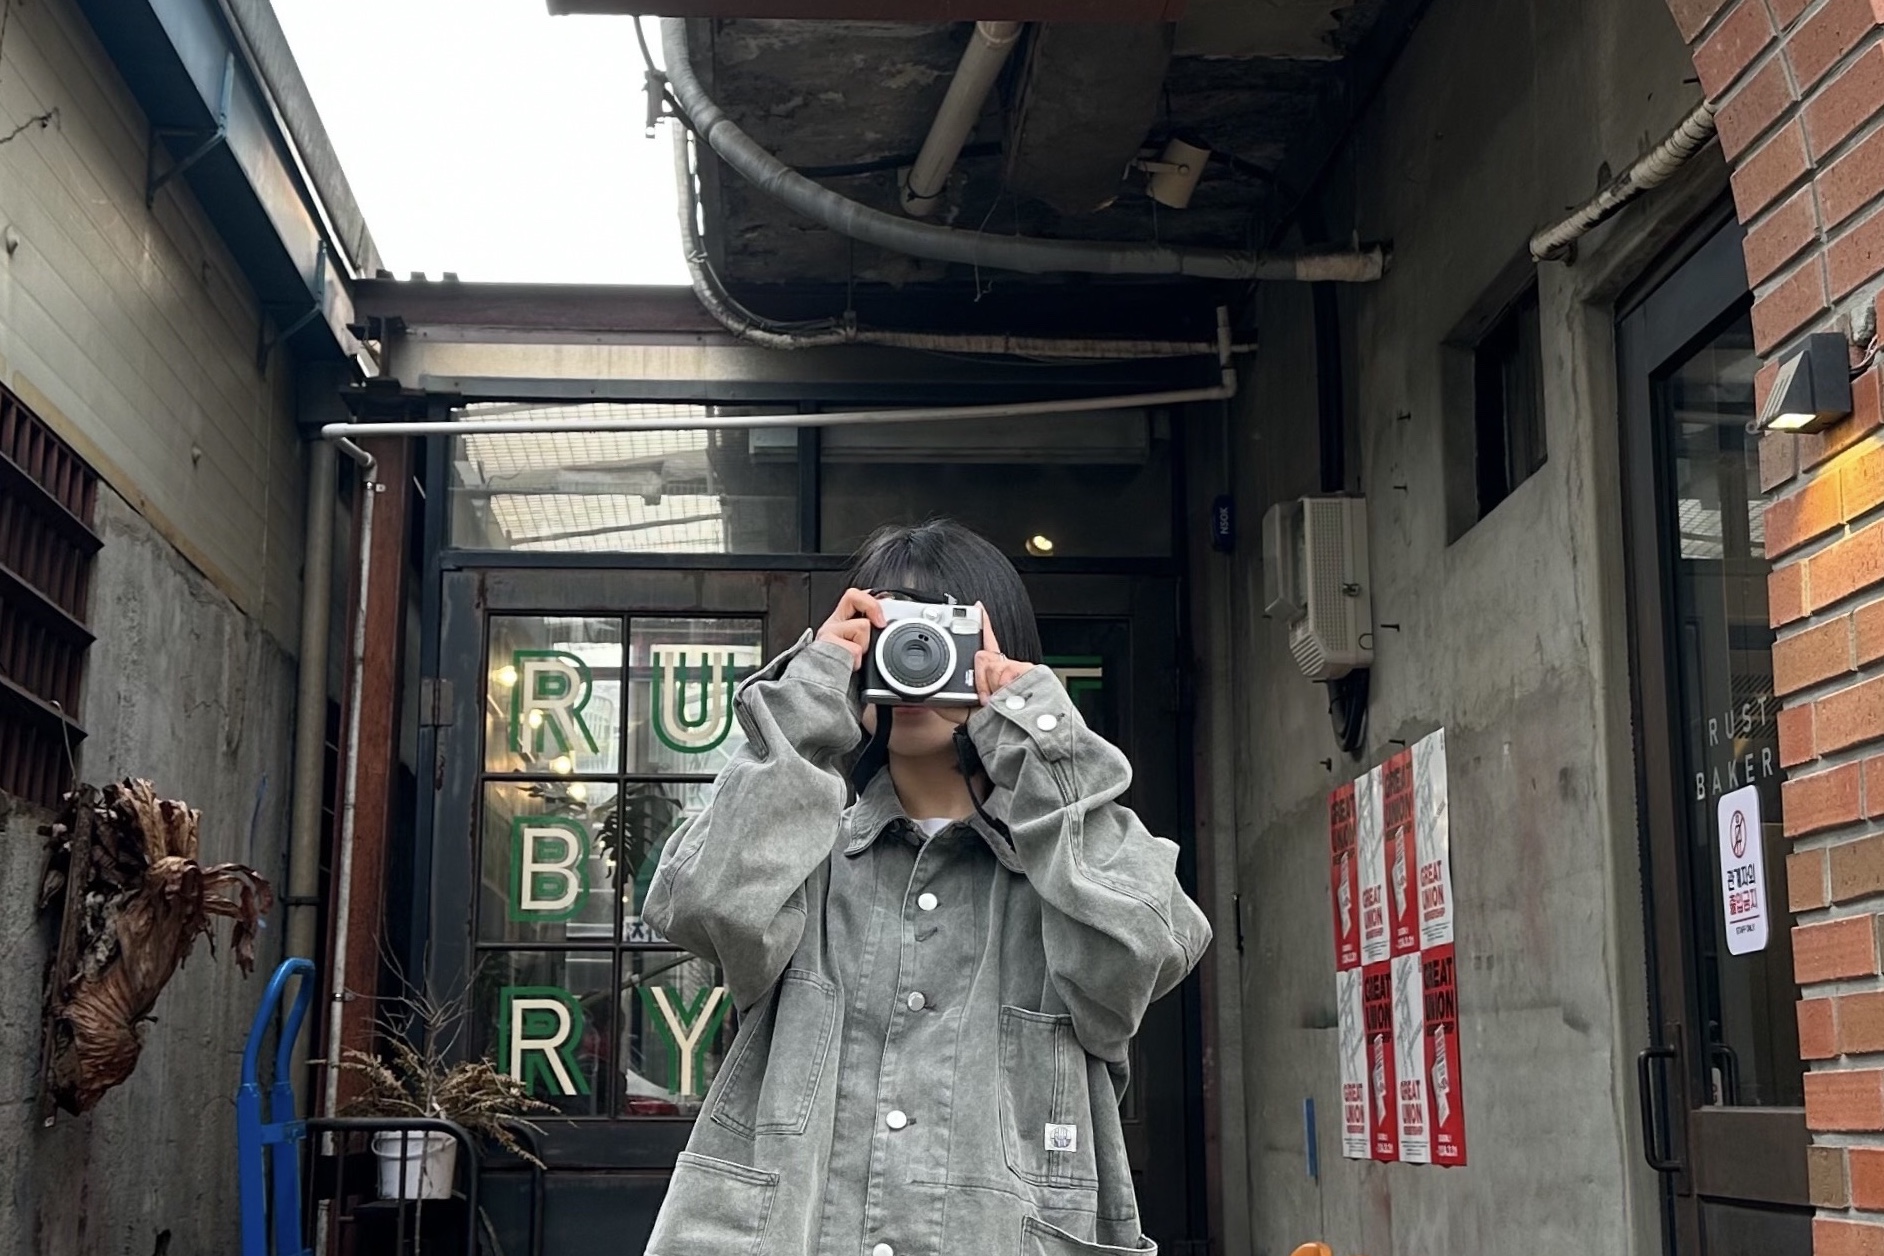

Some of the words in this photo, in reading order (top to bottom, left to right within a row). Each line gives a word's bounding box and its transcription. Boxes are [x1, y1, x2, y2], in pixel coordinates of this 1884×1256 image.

[1219, 507, 1229, 534] NSOK
[1709, 696, 1767, 746] RUST
[1421, 860, 1442, 886] GREAT
[1727, 863, 1755, 891] 관계자외
[1363, 884, 1382, 908] GREAT
[1422, 884, 1445, 910] UNION
[1729, 888, 1758, 915] 출입금지
[1364, 906, 1383, 930] UNION
[1424, 957, 1453, 990] GREAT
[1364, 973, 1391, 1002] GREAT
[1365, 1001, 1391, 1031] UNION
[1425, 990, 1455, 1022] UNION
[1343, 1083, 1363, 1102] GREAT
[1401, 1080, 1420, 1100] GREAT
[1344, 1104, 1364, 1124] UNION
[1402, 1103, 1423, 1124] UNION
